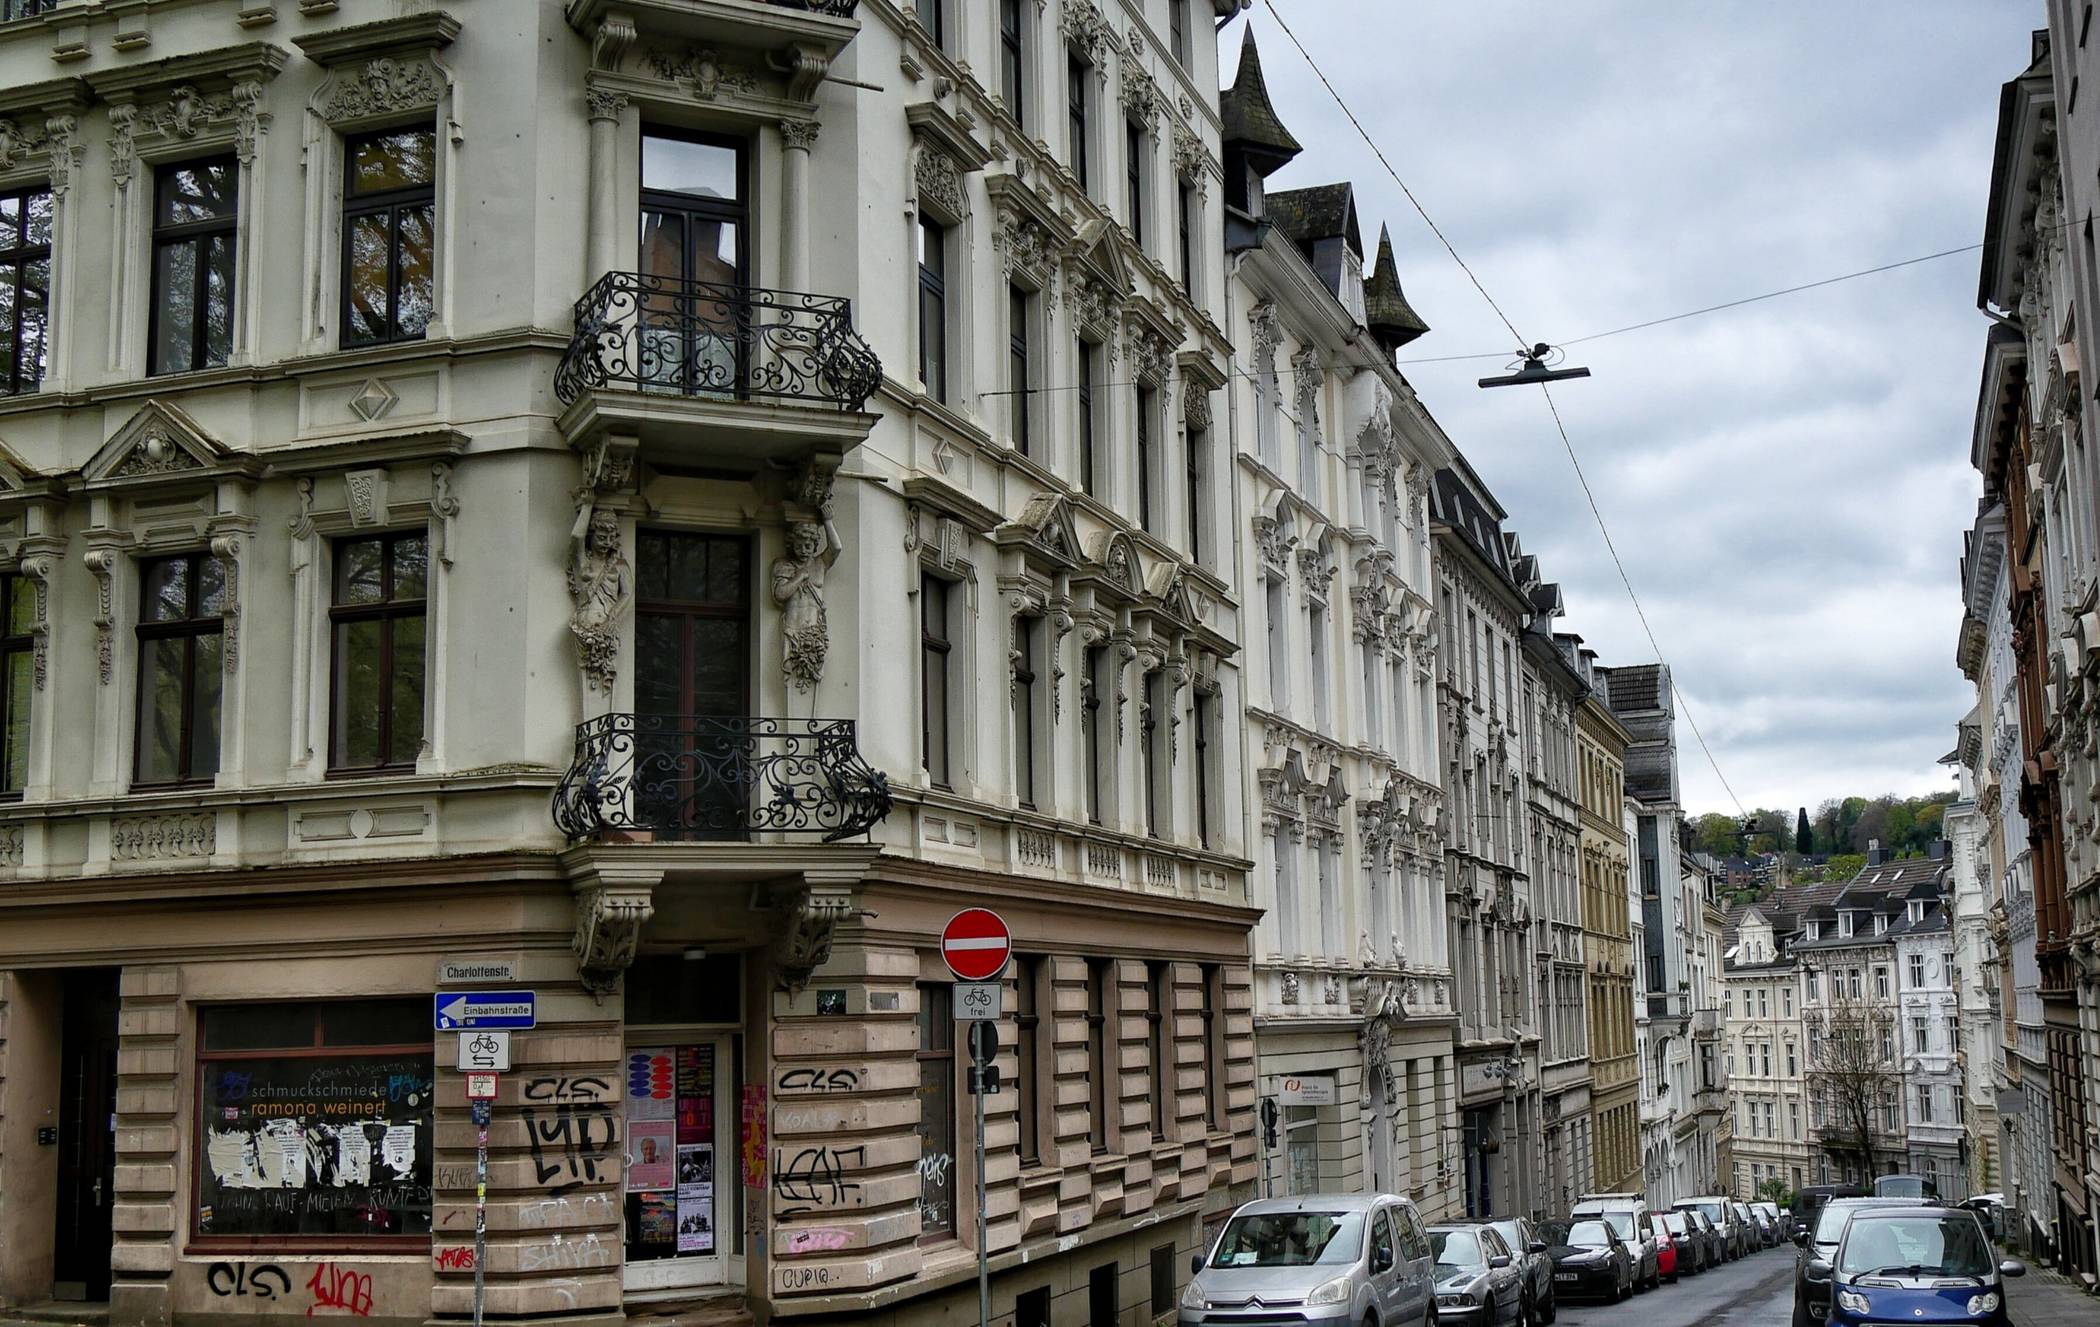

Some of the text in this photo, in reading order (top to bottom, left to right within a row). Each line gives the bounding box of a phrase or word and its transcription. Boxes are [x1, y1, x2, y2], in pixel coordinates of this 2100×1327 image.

[447, 966, 510, 978] Charlottenstr.
[463, 1005, 529, 1015] Einbahnstraße
[970, 1007, 986, 1016] frei
[252, 1080, 387, 1098] schmuckschmiede
[251, 1101, 316, 1117] ramona
[324, 1099, 386, 1116] weinert
